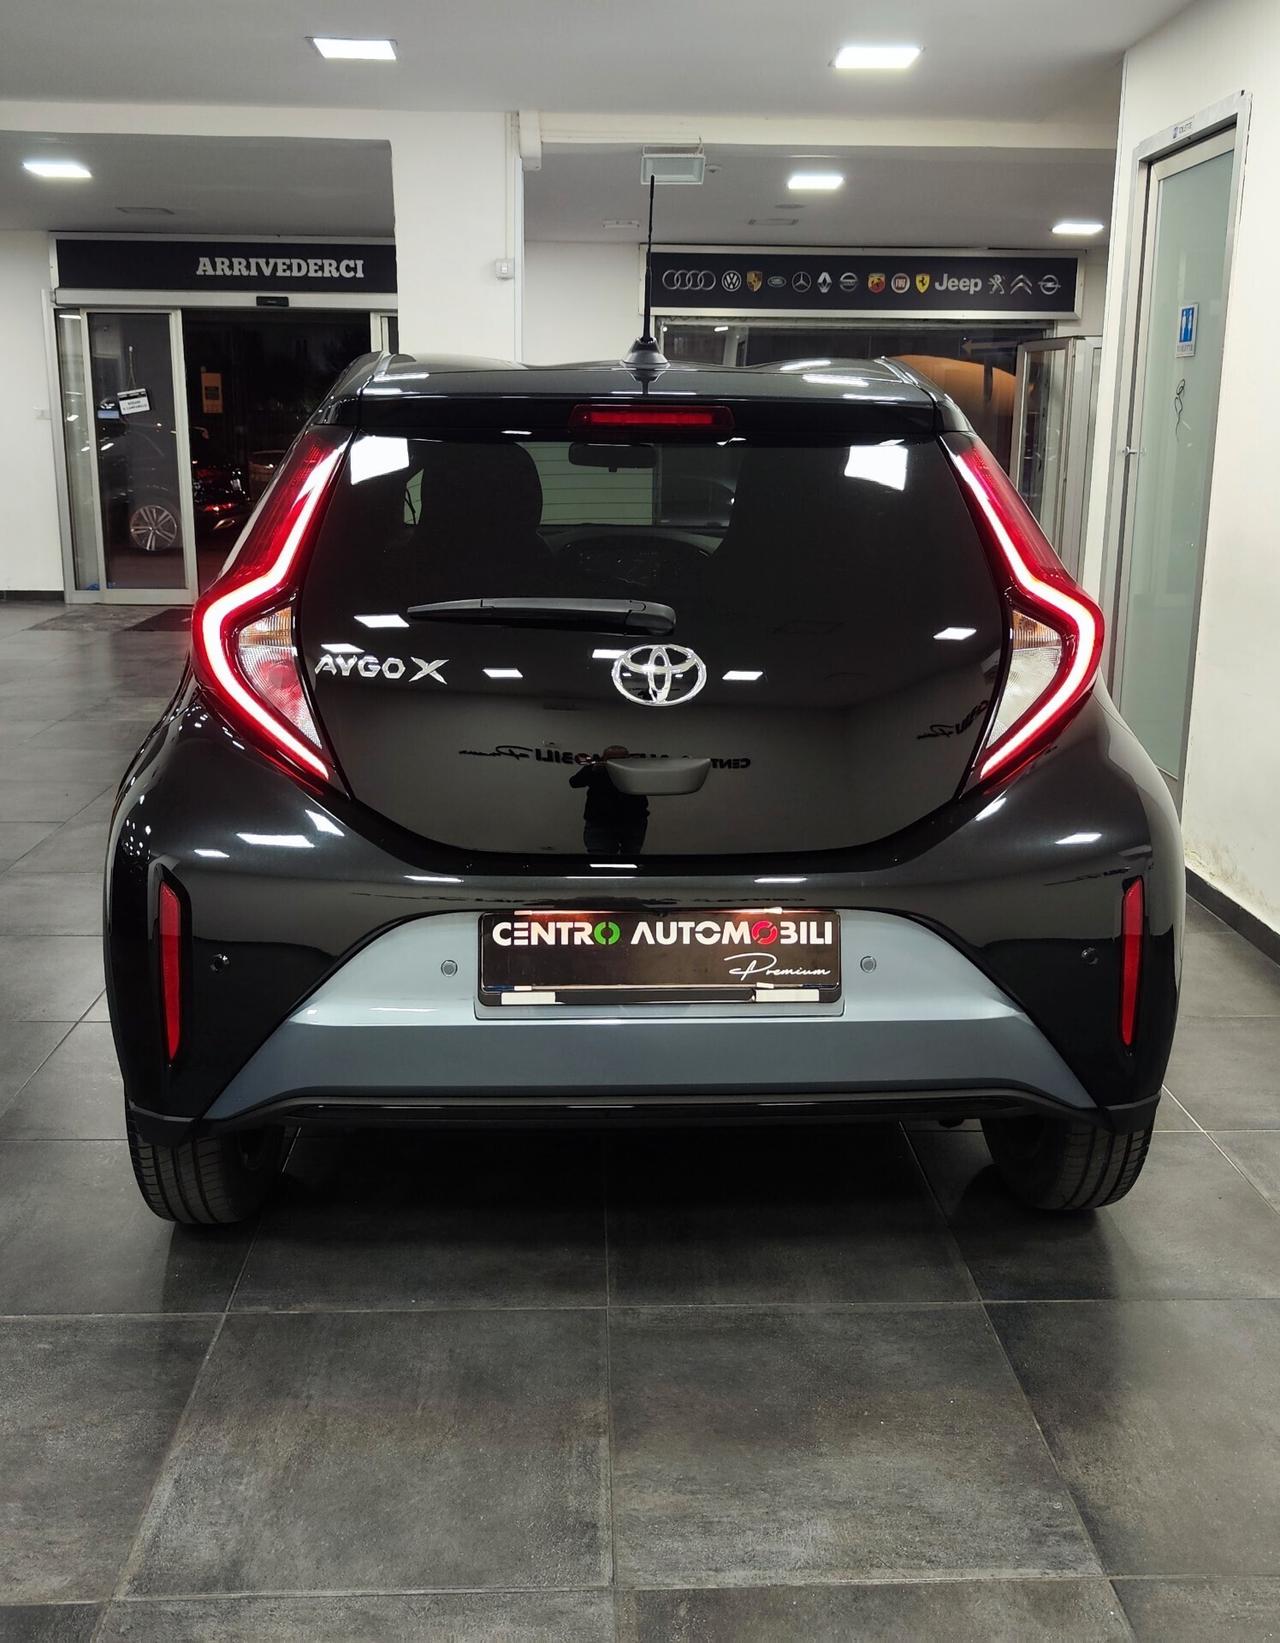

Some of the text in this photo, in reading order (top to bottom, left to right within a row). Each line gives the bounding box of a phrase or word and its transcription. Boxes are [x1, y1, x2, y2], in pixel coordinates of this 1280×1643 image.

[196, 257, 365, 278] ARRIVEDERCI
[935, 274, 983, 294] Jeep
[315, 654, 450, 685] AYGO X
[492, 920, 833, 945] CENTRO AUTOMOBILI
[723, 952, 831, 981] Premium
